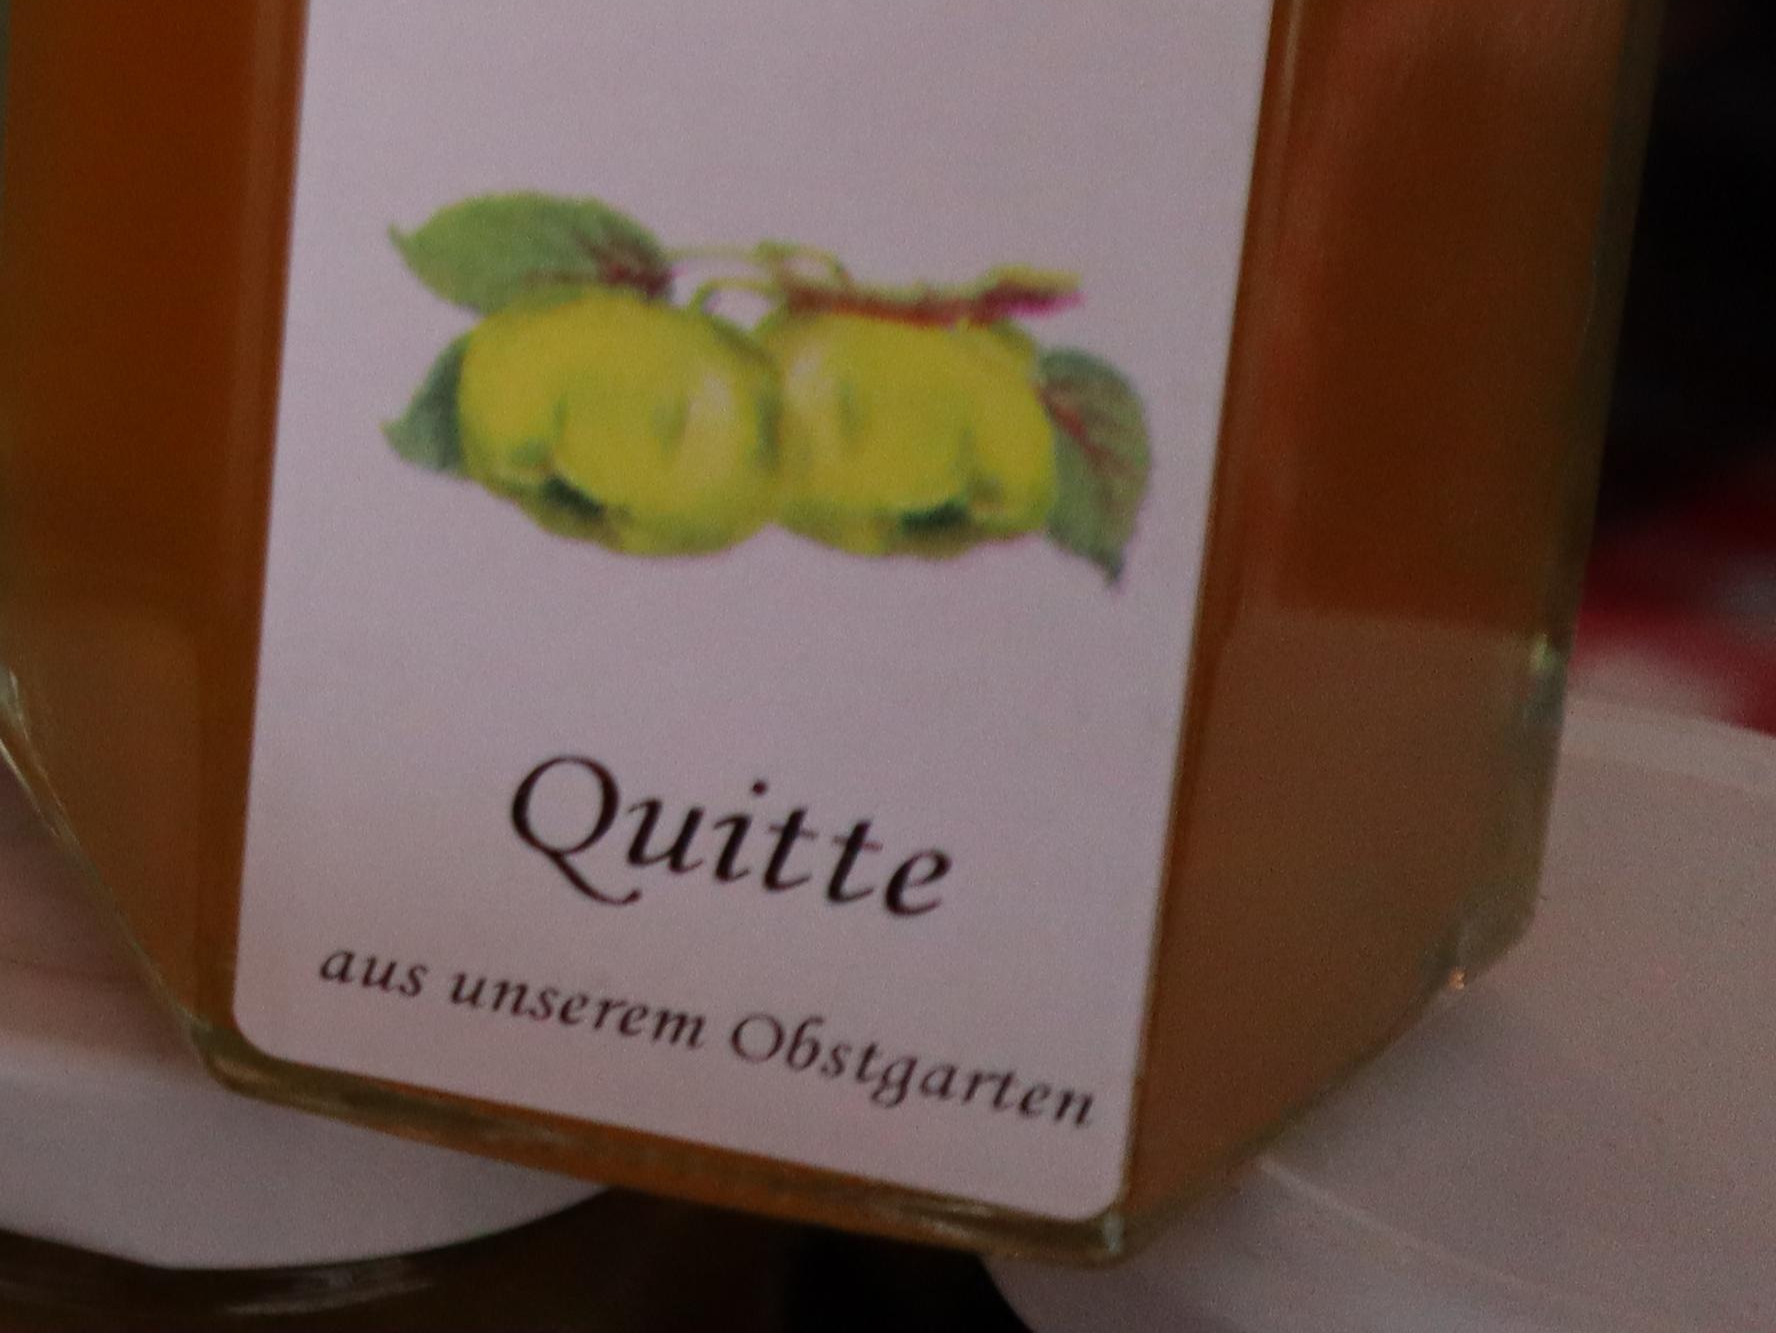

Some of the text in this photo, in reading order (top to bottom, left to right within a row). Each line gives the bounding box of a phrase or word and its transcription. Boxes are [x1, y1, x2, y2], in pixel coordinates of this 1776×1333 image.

[509, 753, 954, 918] Quitte
[319, 945, 1096, 1129] aus unserem Obstgarten
